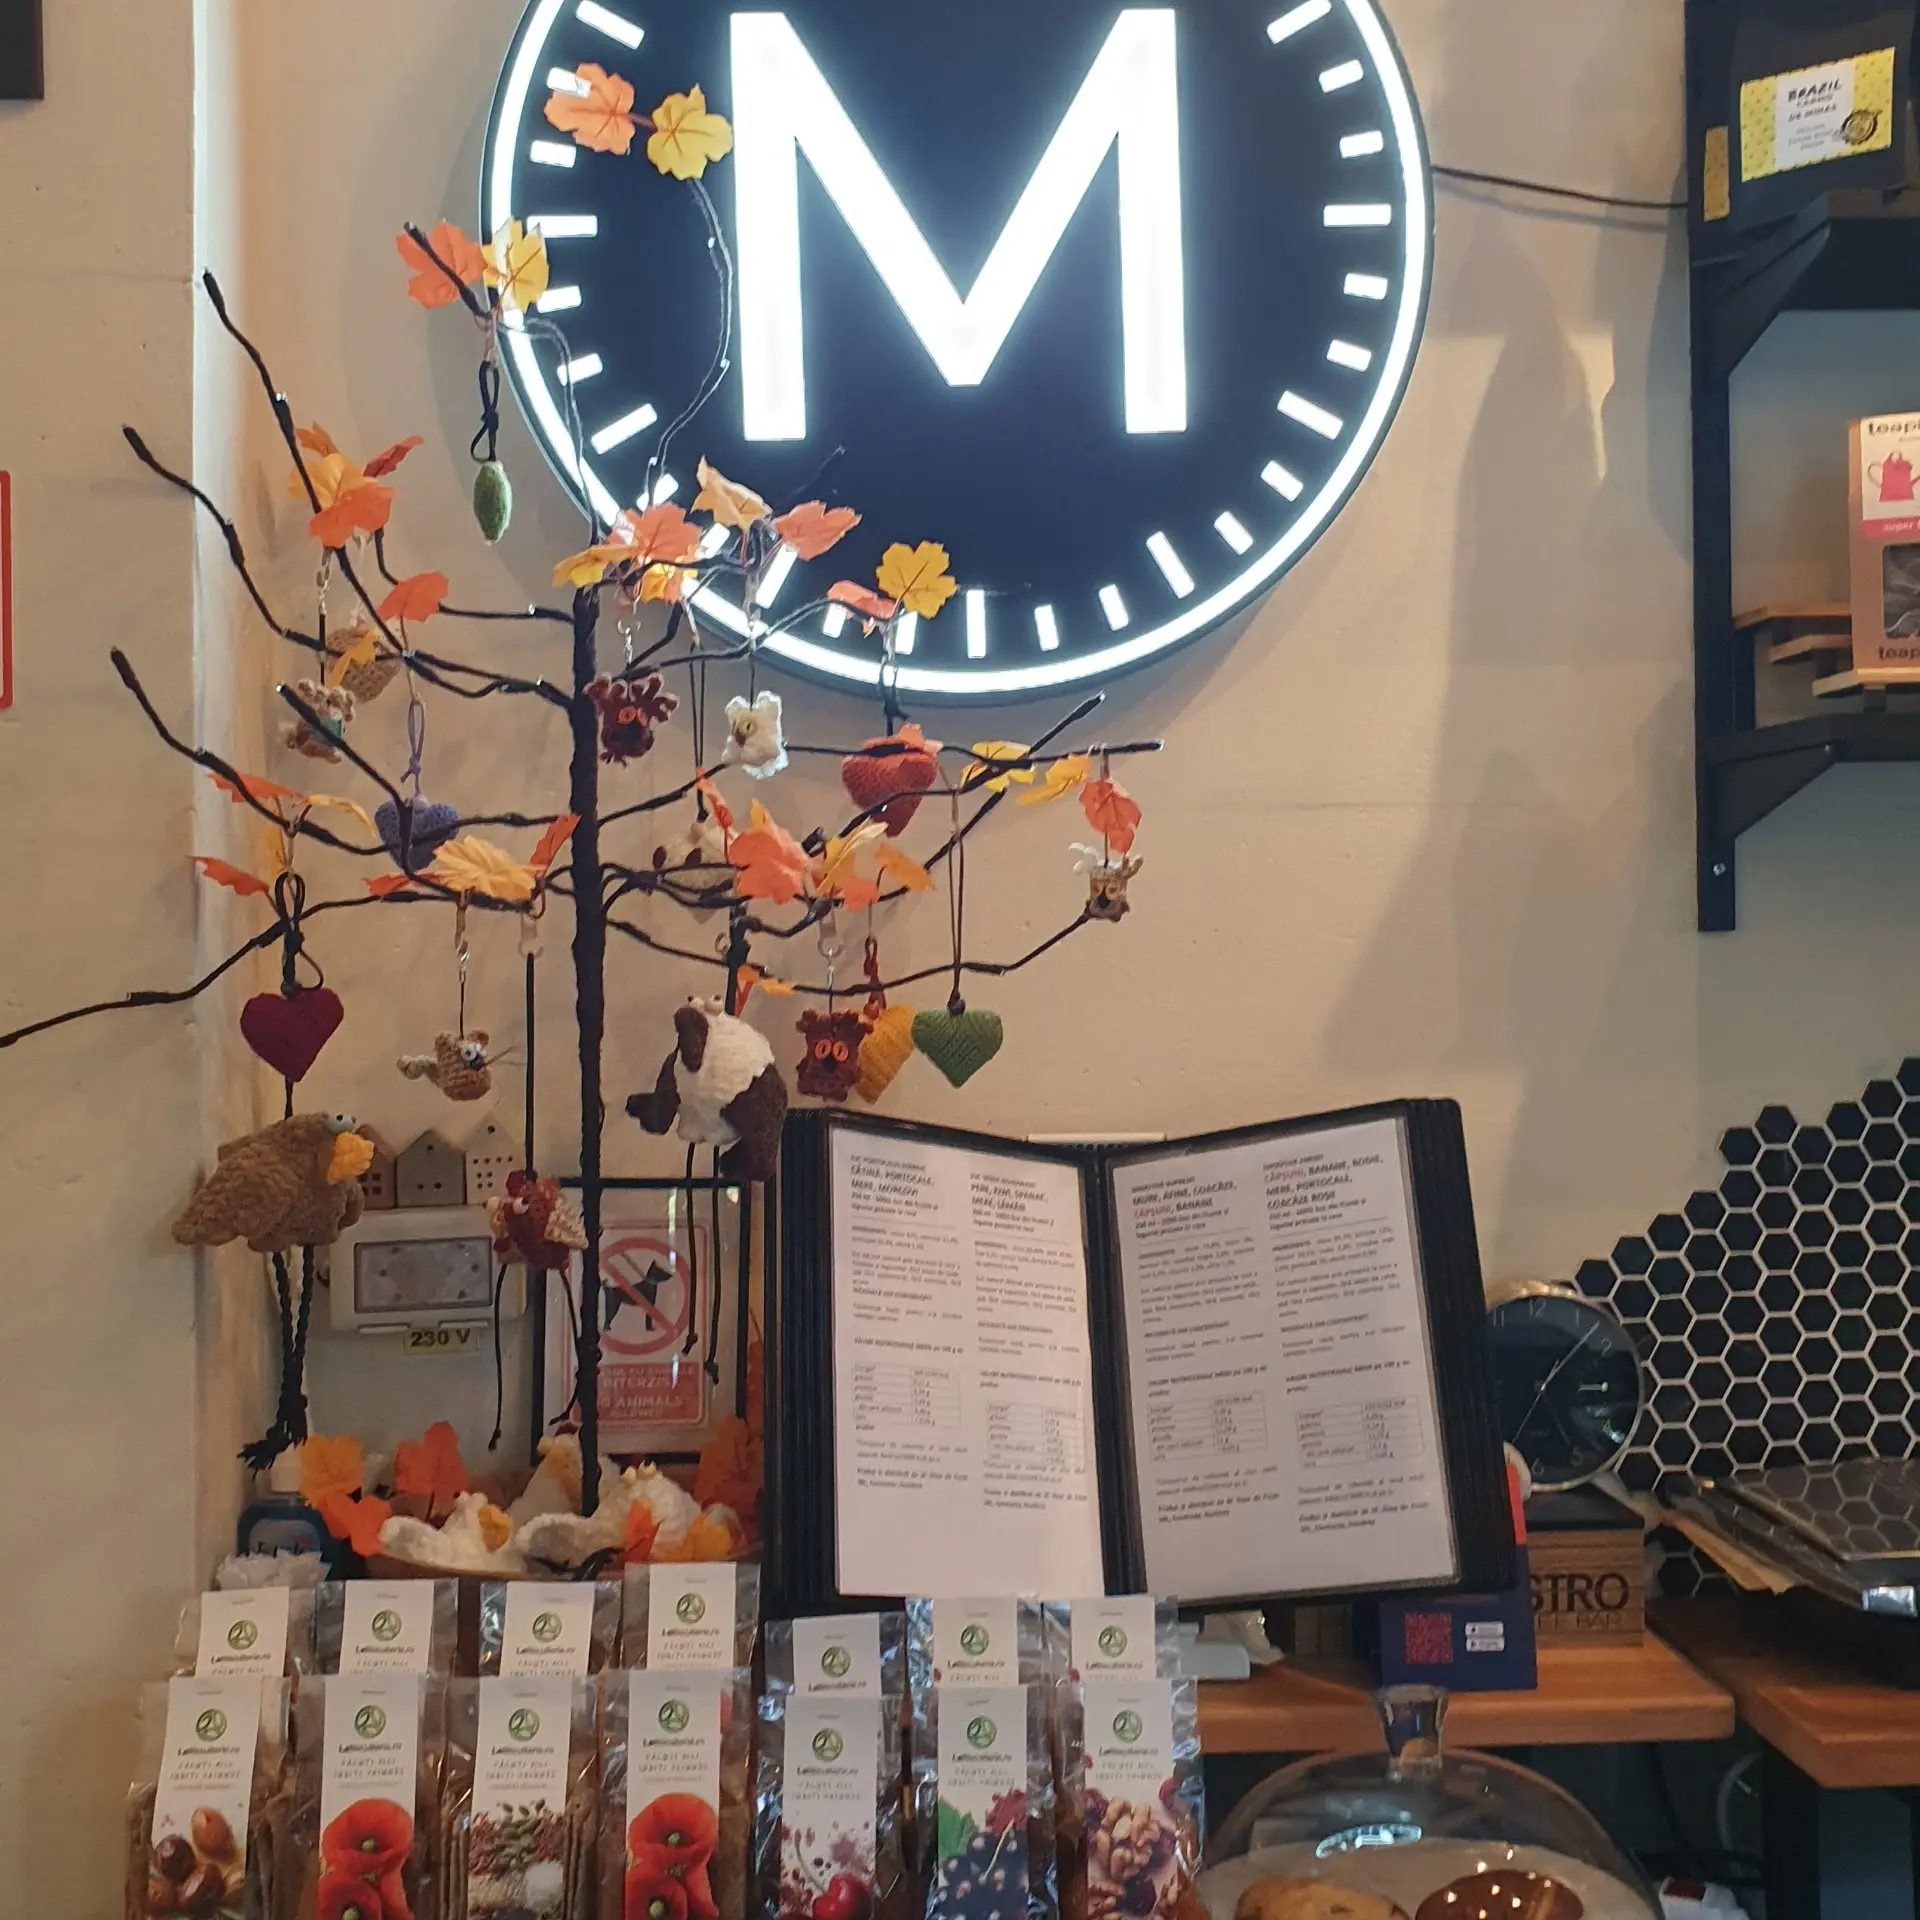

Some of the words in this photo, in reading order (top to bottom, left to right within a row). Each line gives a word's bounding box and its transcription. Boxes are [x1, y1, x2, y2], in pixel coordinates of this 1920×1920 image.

[1788, 78, 1842, 102] BRAZIL
[729, 8, 1187, 441] M
[1529, 1299, 1547, 1317] 12
[410, 1329, 450, 1348] 230
[456, 1327, 471, 1344] V
